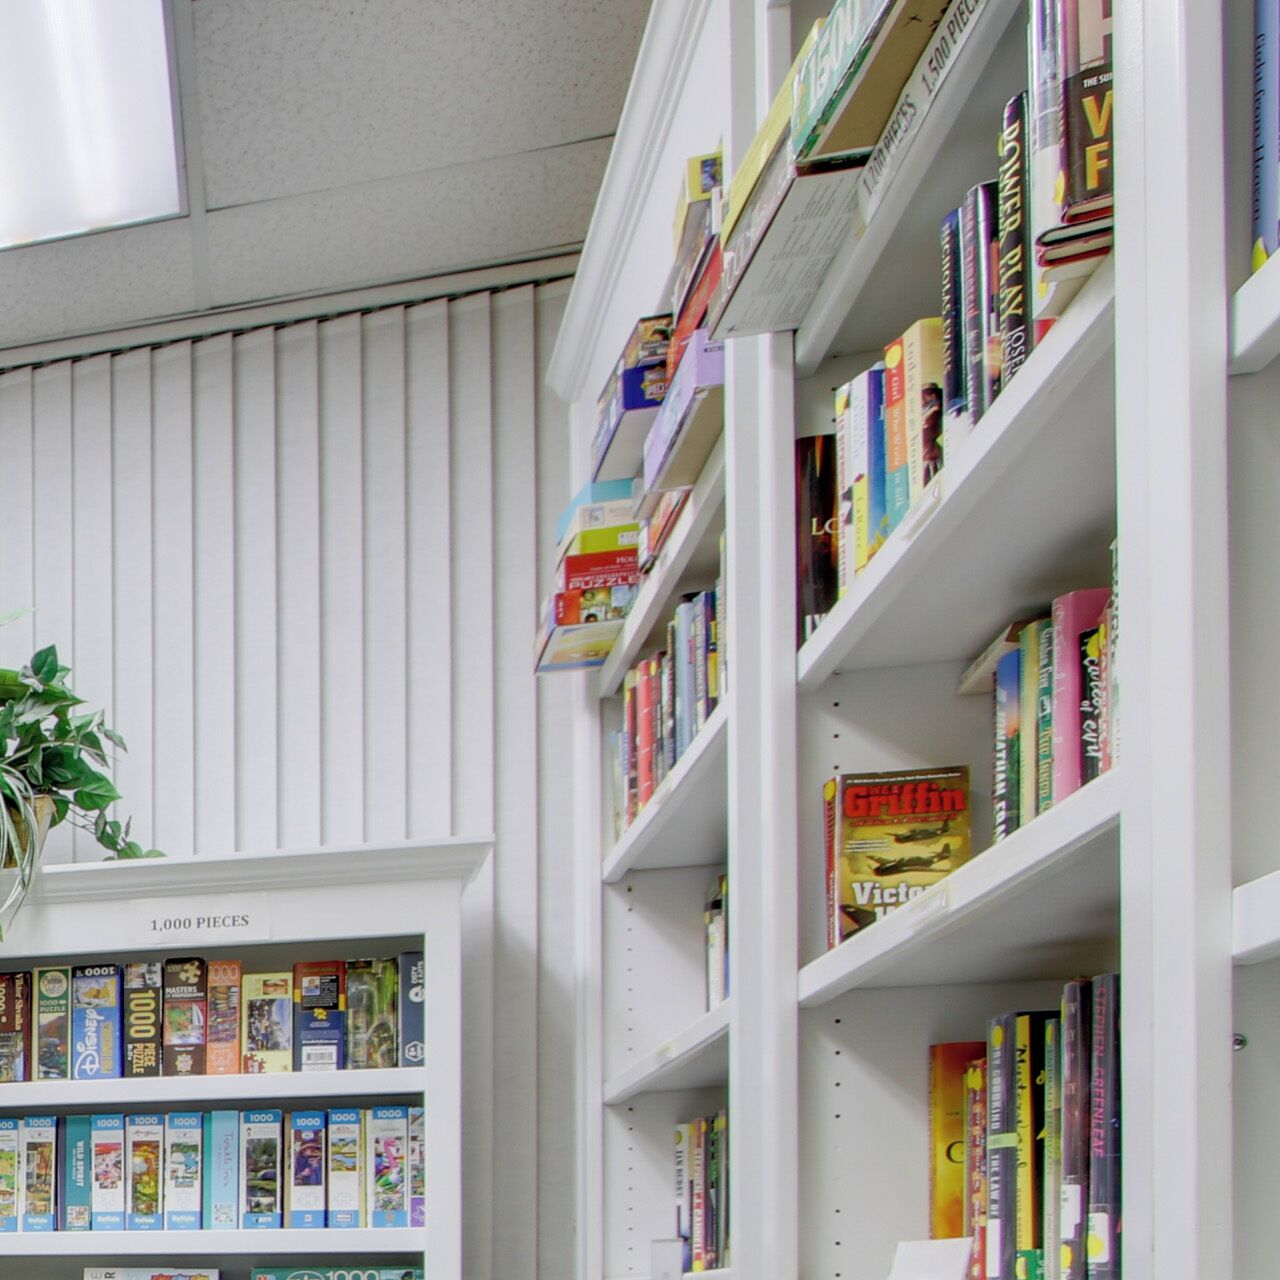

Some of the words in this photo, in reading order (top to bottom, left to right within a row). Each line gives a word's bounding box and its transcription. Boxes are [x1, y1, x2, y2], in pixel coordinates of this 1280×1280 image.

[884, 94, 918, 155] PIECES
[1002, 120, 1026, 246] POWER
[1007, 247, 1026, 318] PLAY
[844, 786, 966, 819] Griffin
[150, 917, 192, 932] 1,000
[197, 914, 249, 929] PIECES
[129, 990, 155, 1038] 1000
[1095, 987, 1108, 1058] STEPHEN
[133, 1043, 145, 1074] PUZZLE
[143, 1043, 156, 1067] PIECE
[96, 1119, 119, 1127] 1000
[174, 1117, 196, 1125] 1000
[250, 1113, 273, 1122] 1000
[296, 1118, 320, 1126] 1000
[332, 1113, 356, 1121] 1000
[377, 1110, 402, 1118] 1000
[1092, 1067, 1106, 1157] GREENLEAF
